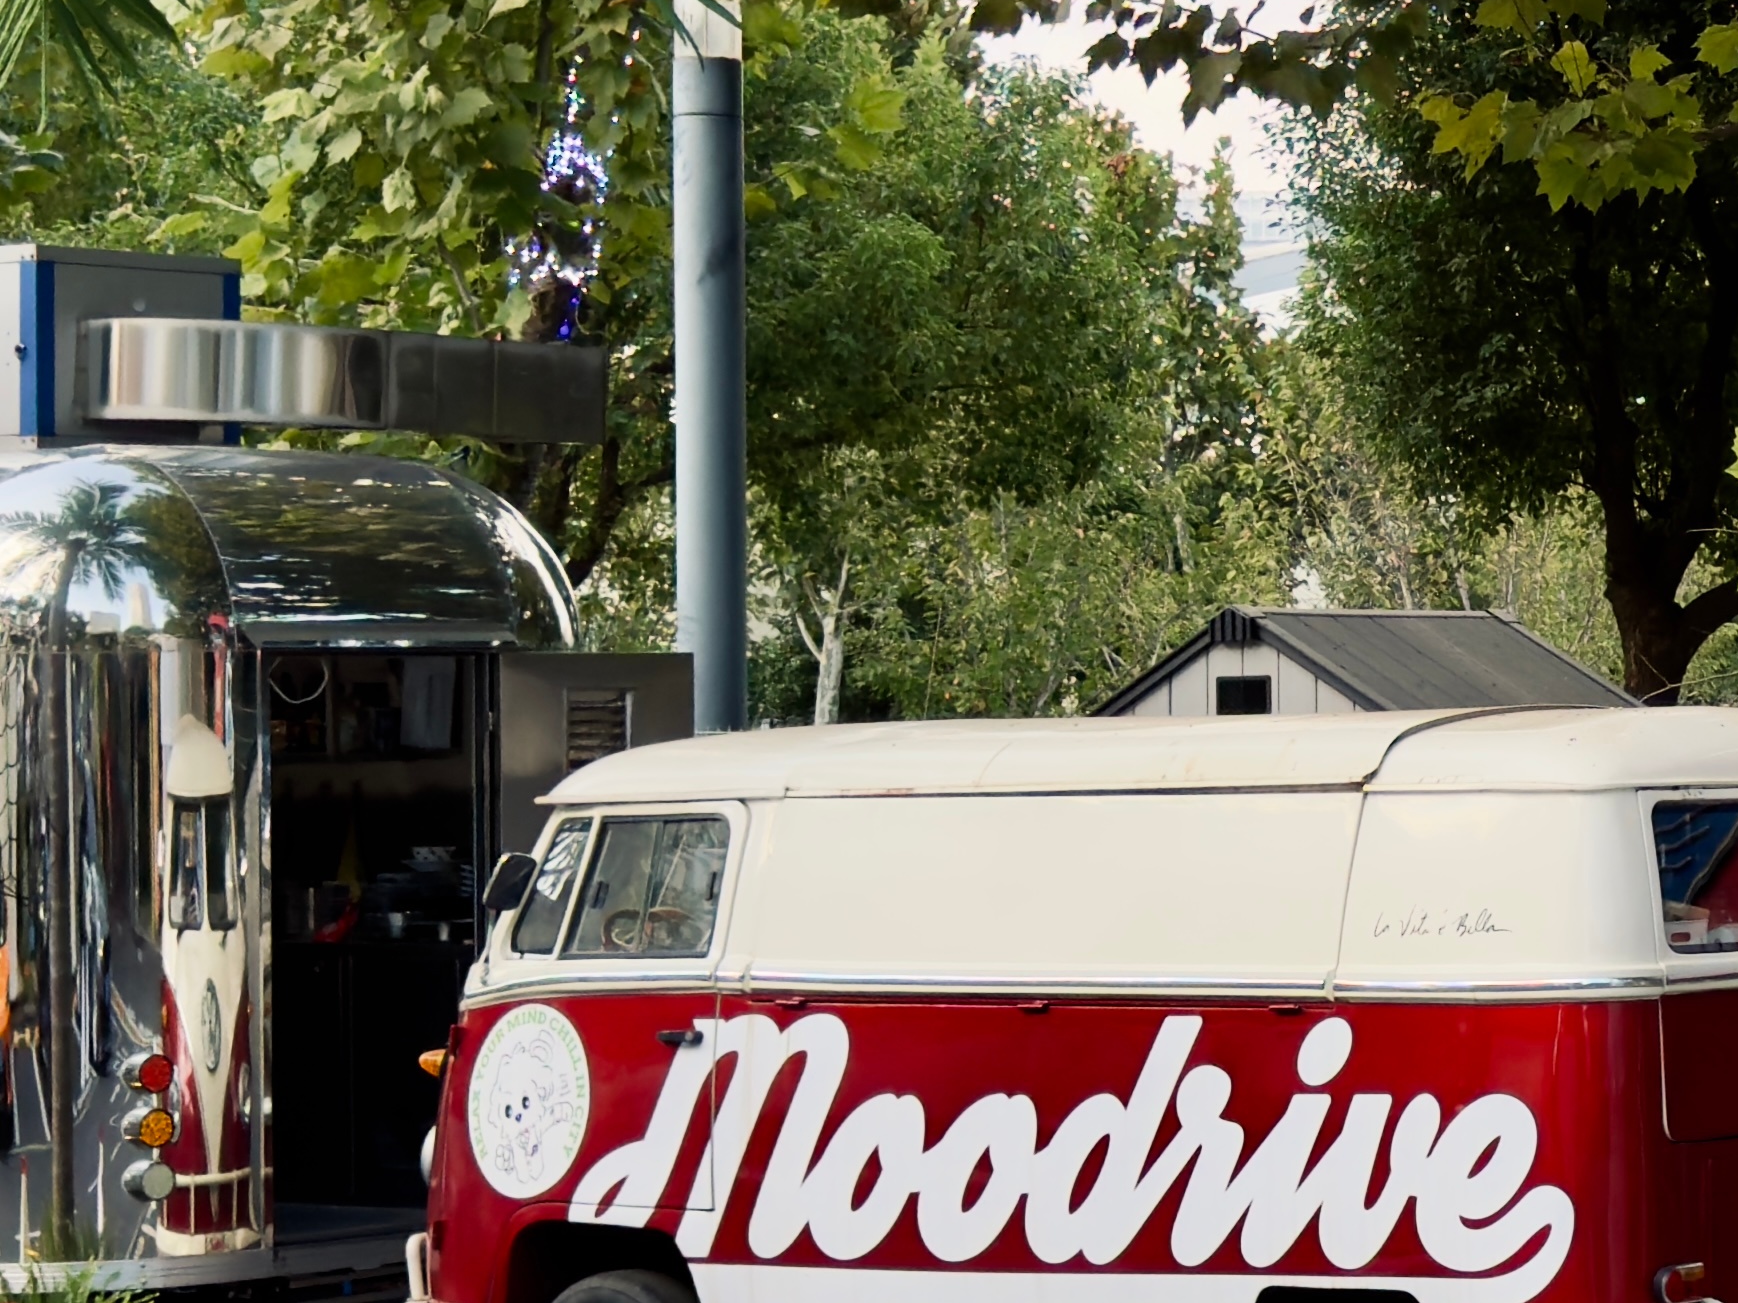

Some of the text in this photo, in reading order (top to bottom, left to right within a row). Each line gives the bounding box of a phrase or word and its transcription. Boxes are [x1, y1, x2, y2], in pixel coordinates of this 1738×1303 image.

[472, 1010, 587, 1162] RELAX YOUR MIND CHILL IN CITY
[567, 1012, 1575, 1296] Moodrive
